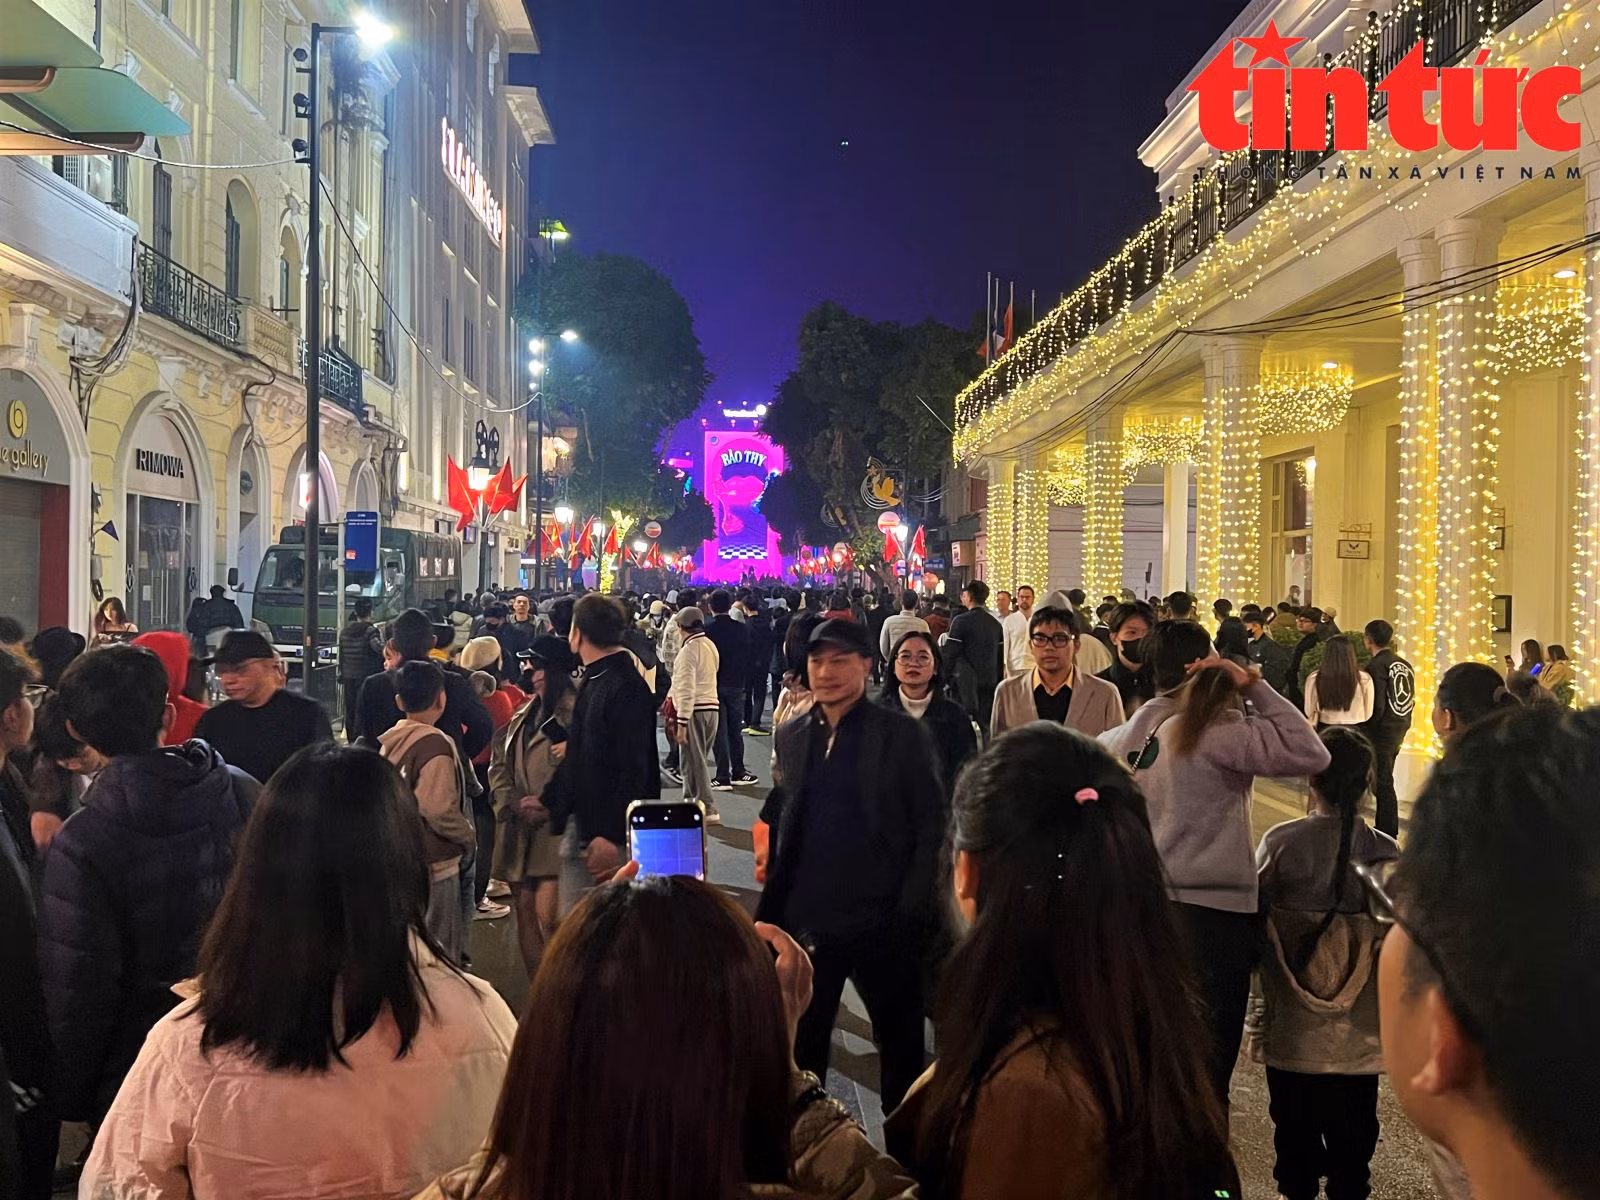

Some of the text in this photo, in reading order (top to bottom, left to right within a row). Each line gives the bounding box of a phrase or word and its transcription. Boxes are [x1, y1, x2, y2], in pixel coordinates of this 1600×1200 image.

[11, 439, 49, 477] gallery
[135, 448, 184, 478] RIMOWA
[744, 450, 767, 467] THY
